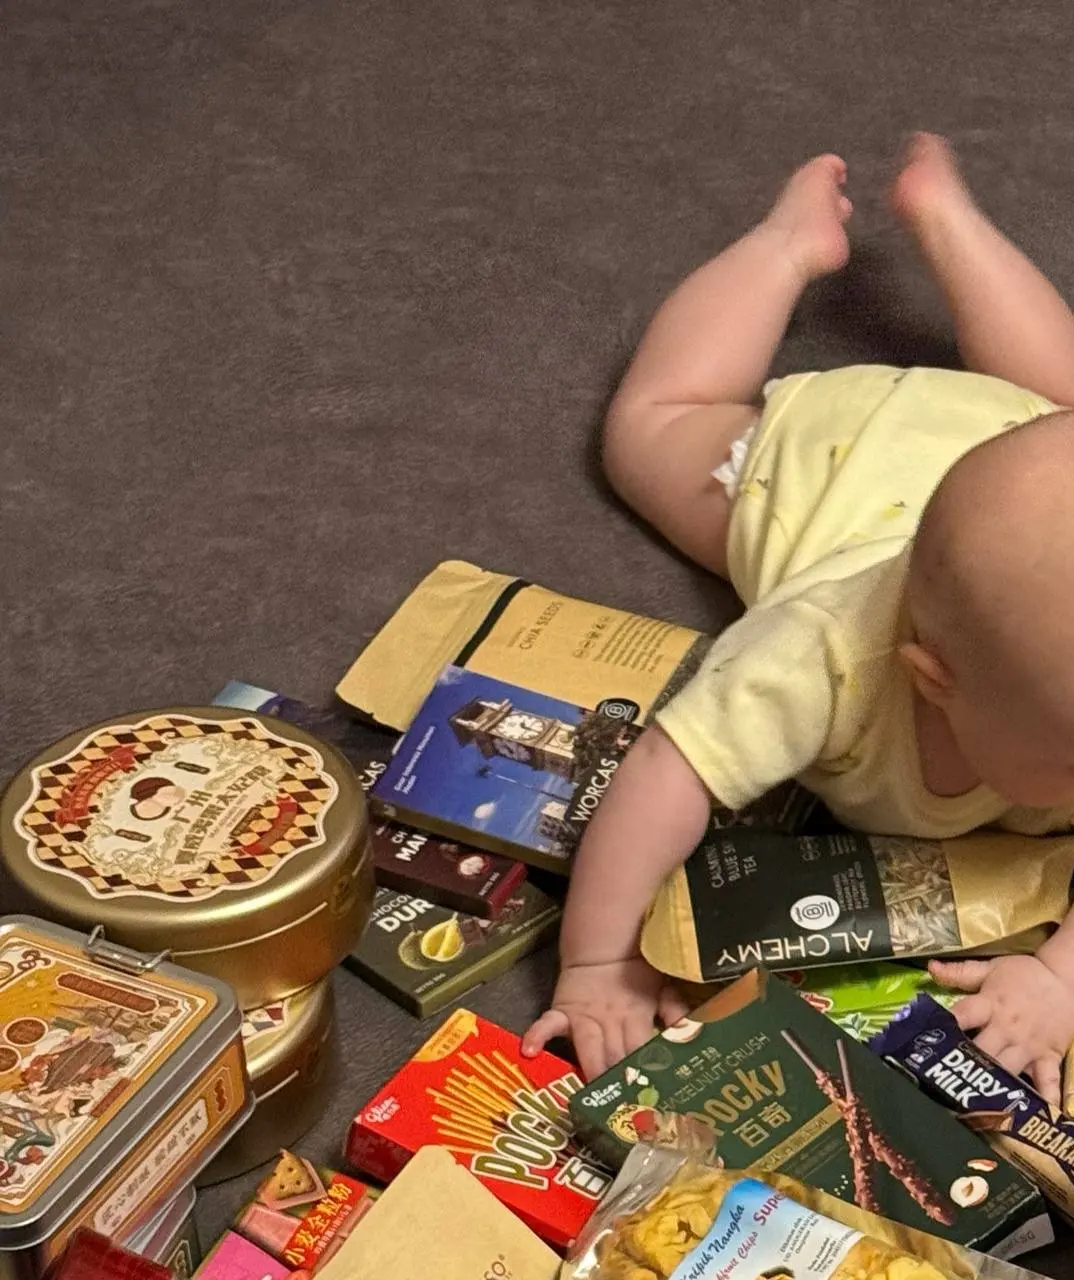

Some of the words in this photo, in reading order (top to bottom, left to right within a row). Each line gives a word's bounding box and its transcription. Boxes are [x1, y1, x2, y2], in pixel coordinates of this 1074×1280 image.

[520, 625, 542, 651] CHIA
[571, 757, 618, 823] WORCAS
[706, 841, 724, 889] CALMIN
[743, 855, 756, 877] TEA
[376, 898, 435, 933] DUR
[717, 929, 875, 967] ALCHEMY
[726, 1032, 771, 1067] CRUSH
[924, 1062, 981, 1109] MILK
[941, 1049, 1009, 1098] DAIRY
[733, 1102, 792, 1148] 百奇
[753, 1190, 785, 1226] Supe
[712, 1204, 744, 1254] Nangka
[738, 1230, 759, 1261] Chips
